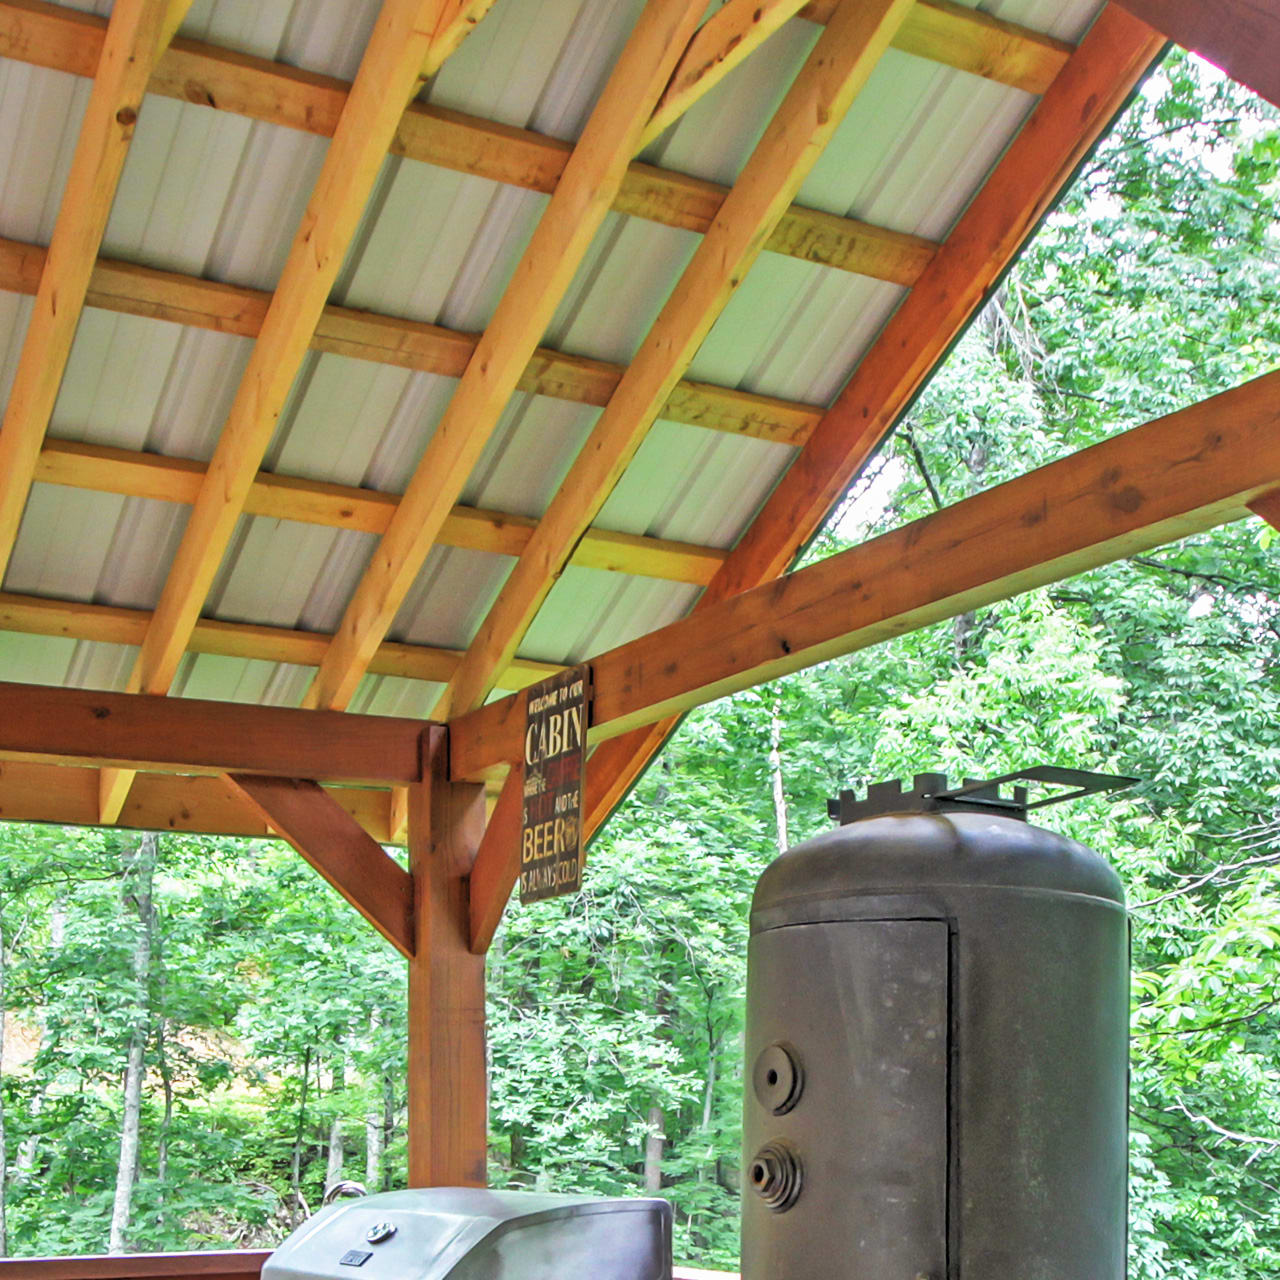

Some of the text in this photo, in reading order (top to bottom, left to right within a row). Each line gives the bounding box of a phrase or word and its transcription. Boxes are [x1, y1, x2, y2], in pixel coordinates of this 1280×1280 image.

[528, 679, 583, 716] WELCOME TO OUR
[525, 703, 584, 766] CABIN
[522, 818, 565, 864] BEER
[528, 863, 556, 893] ALWAYS
[556, 858, 578, 885] COLD
